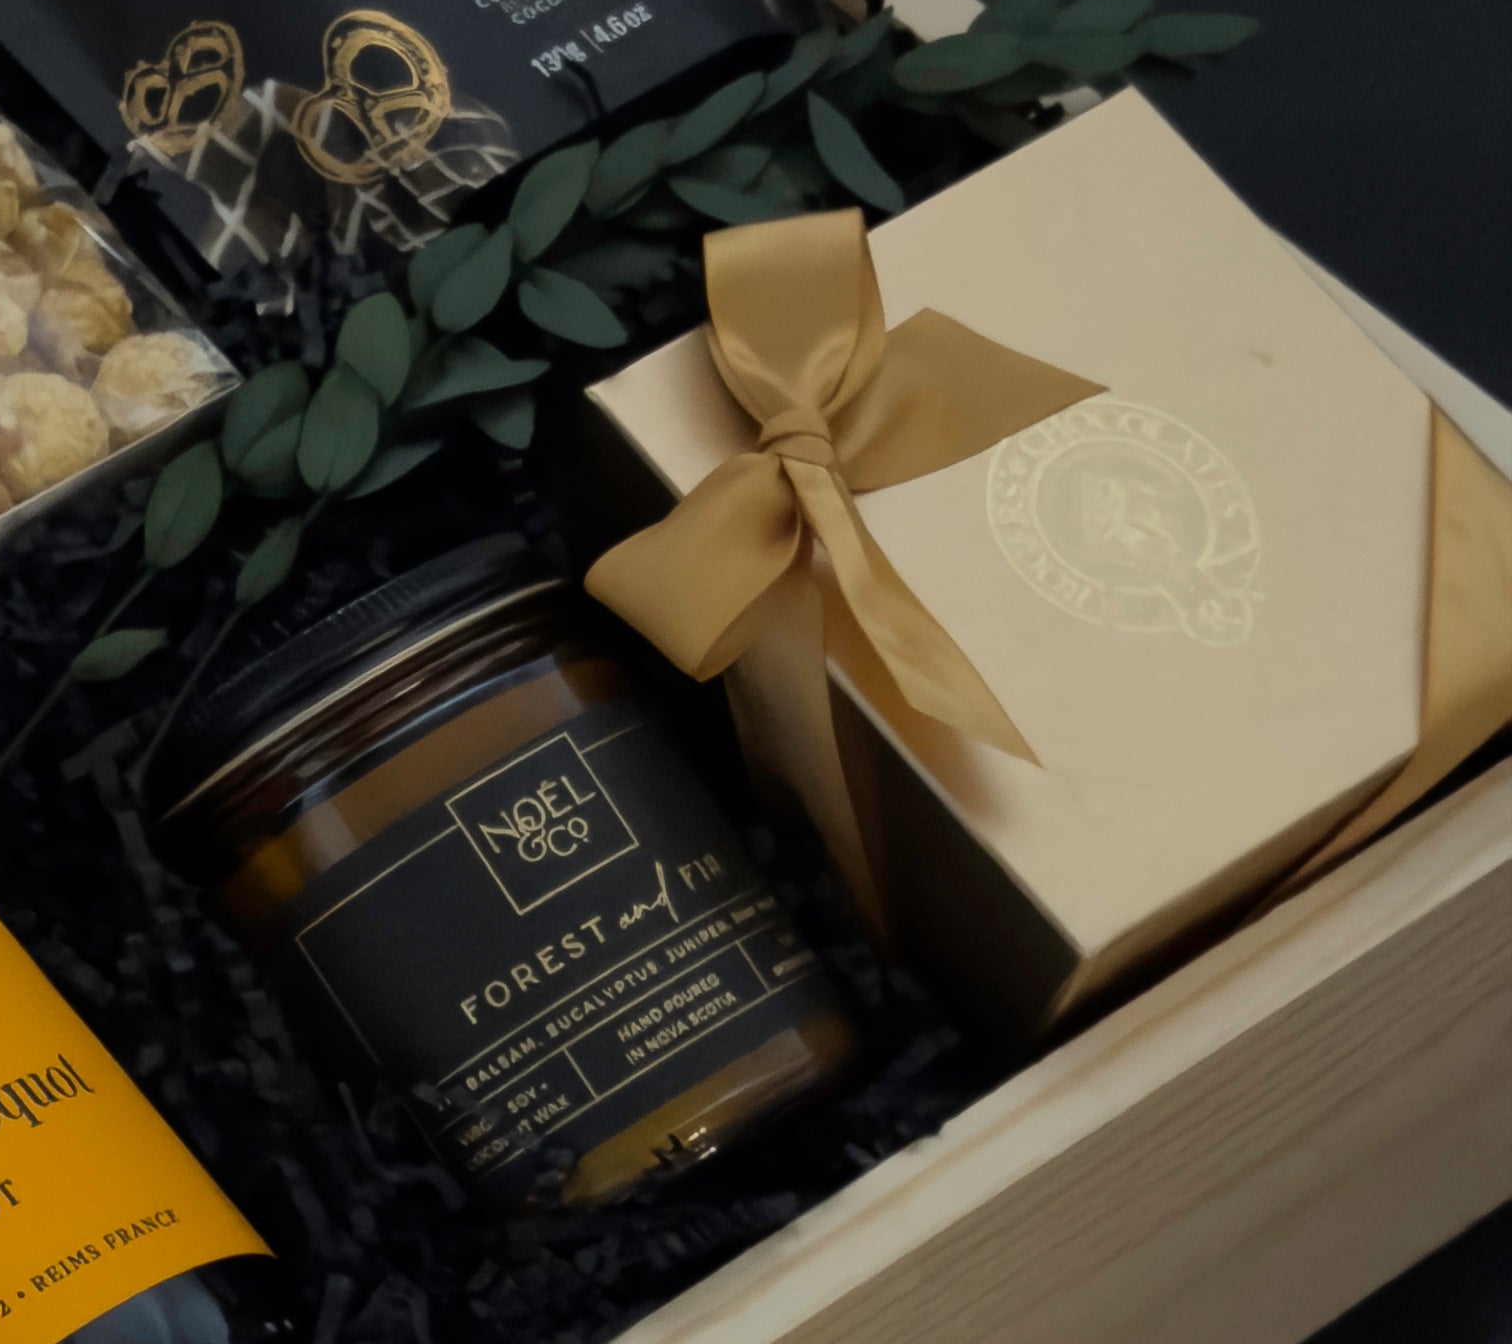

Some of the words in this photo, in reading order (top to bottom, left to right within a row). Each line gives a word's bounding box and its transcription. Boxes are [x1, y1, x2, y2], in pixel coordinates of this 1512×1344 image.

[460, 916, 606, 1025] FOREST
[618, 859, 680, 930] and
[617, 1006, 664, 1043] HAND
[662, 973, 722, 1014] POURED
[625, 1046, 647, 1066] IN
[644, 1021, 688, 1054] NOVA
[688, 991, 738, 1028] SCOTIA
[506, 1088, 538, 1115] SOY
[533, 1093, 572, 1126] WAX
[29, 1243, 102, 1293] REIMS
[102, 1207, 181, 1251] FRANCE
